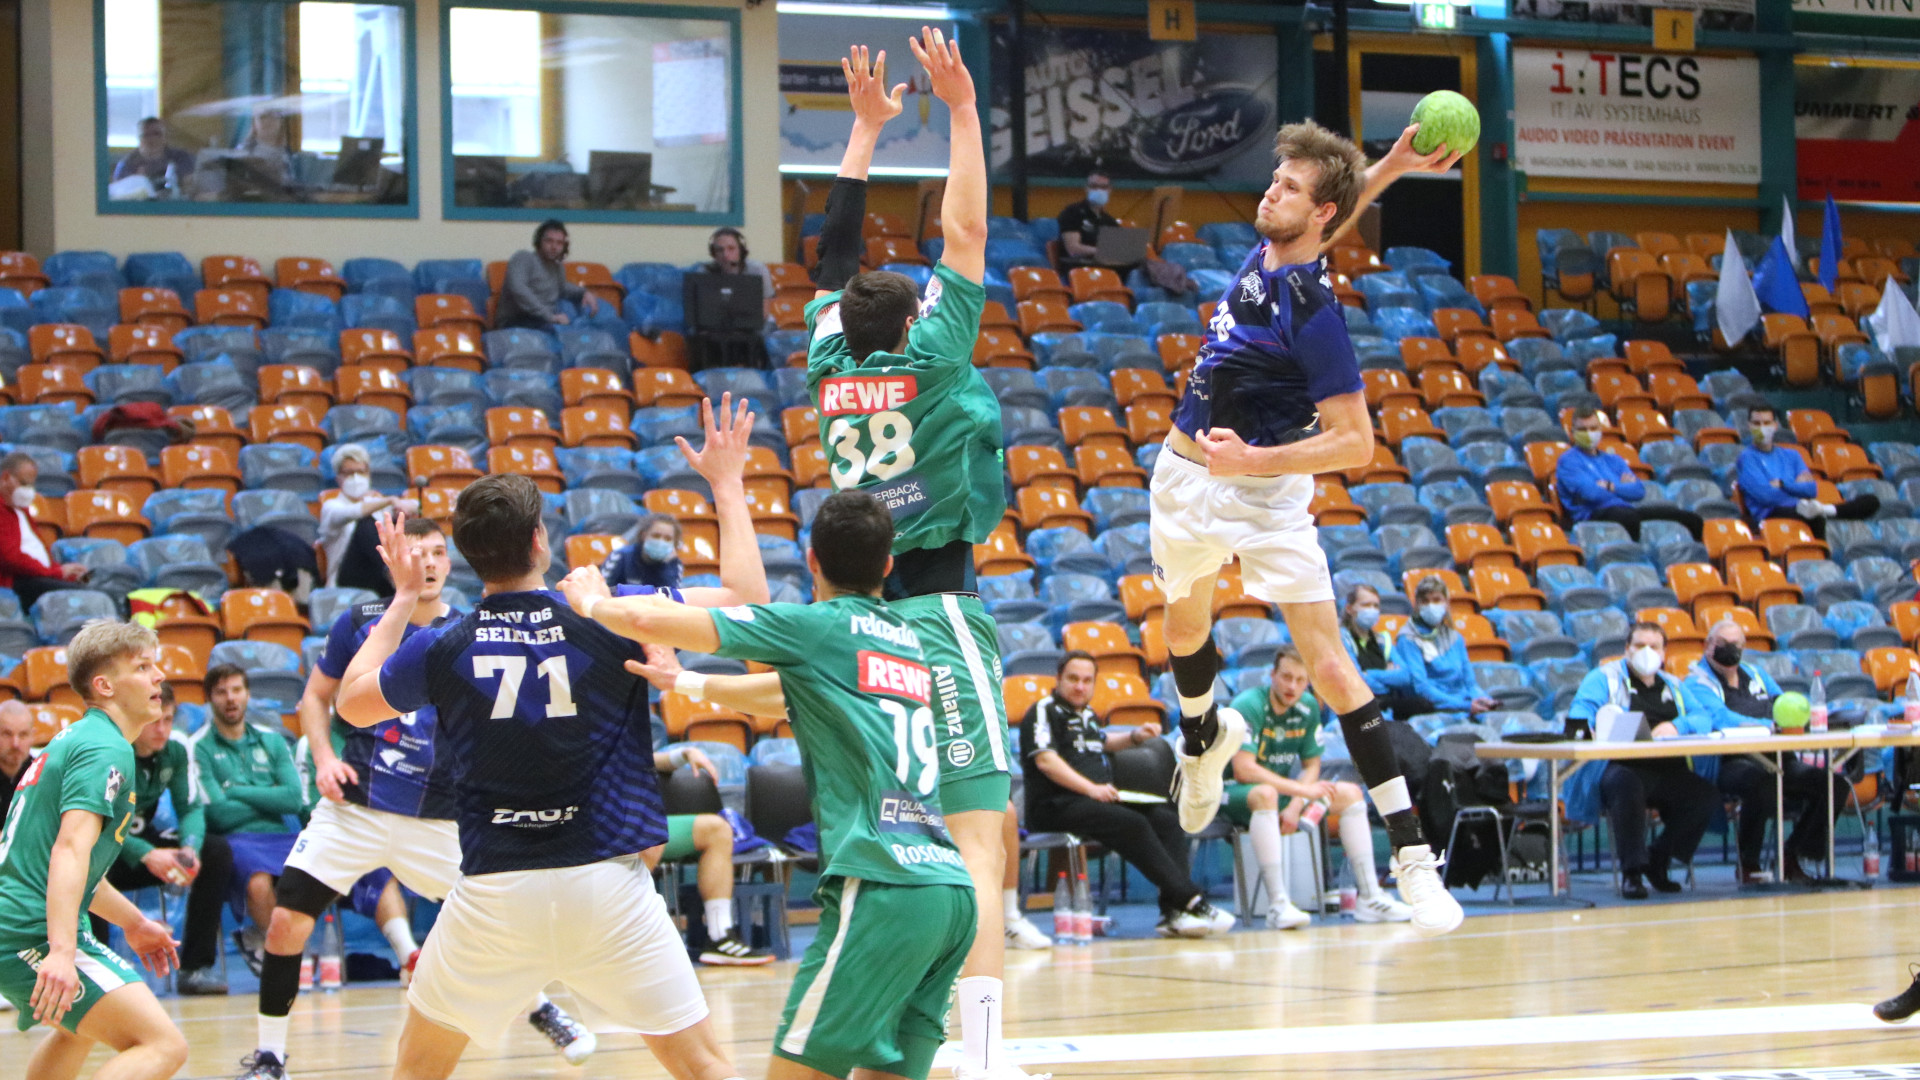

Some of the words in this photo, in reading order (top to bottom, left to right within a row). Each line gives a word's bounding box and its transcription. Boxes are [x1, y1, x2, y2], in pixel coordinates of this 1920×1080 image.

[1165, 105, 1243, 159] Ford
[1604, 103, 1702, 124] SYSTEMHAUS
[1518, 126, 1558, 143] AUDIO
[1562, 129, 1600, 145] VIDEO
[1698, 134, 1737, 151] EVENT
[823, 381, 905, 411] REWE
[828, 410, 917, 491] 38
[529, 607, 553, 624] 06
[472, 654, 578, 720] 71
[867, 656, 932, 702] REWE
[932, 664, 963, 737] Allianz
[878, 698, 939, 795] 19
[296, 839, 308, 853] 5
